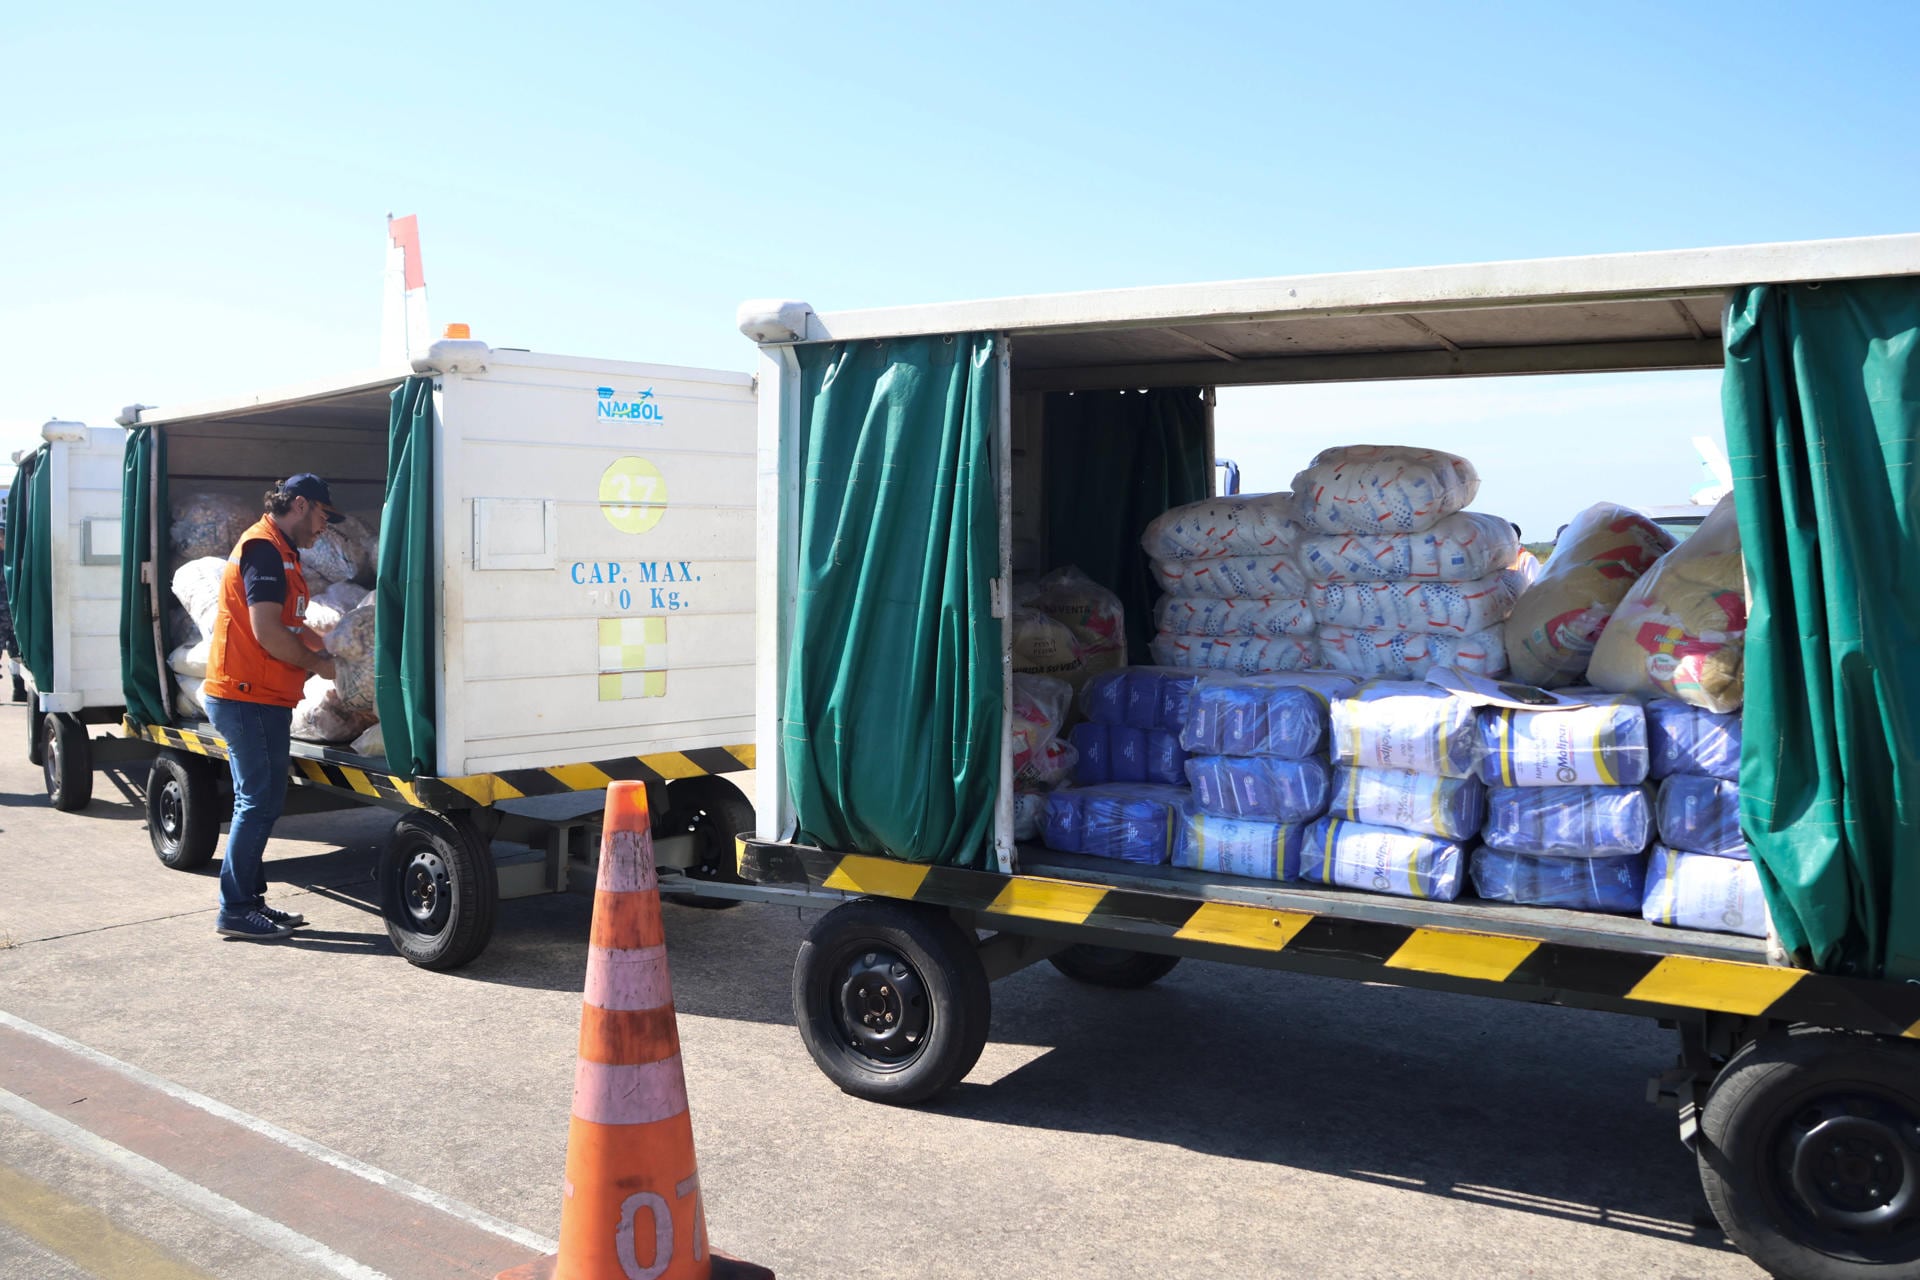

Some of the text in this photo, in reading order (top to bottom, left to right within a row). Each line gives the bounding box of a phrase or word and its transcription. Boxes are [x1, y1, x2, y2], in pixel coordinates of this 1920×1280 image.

[598, 401, 663, 420] NAABOL
[610, 474, 656, 519] 37
[571, 561, 701, 584] CAP. MAX.
[649, 587, 688, 610] Kg.
